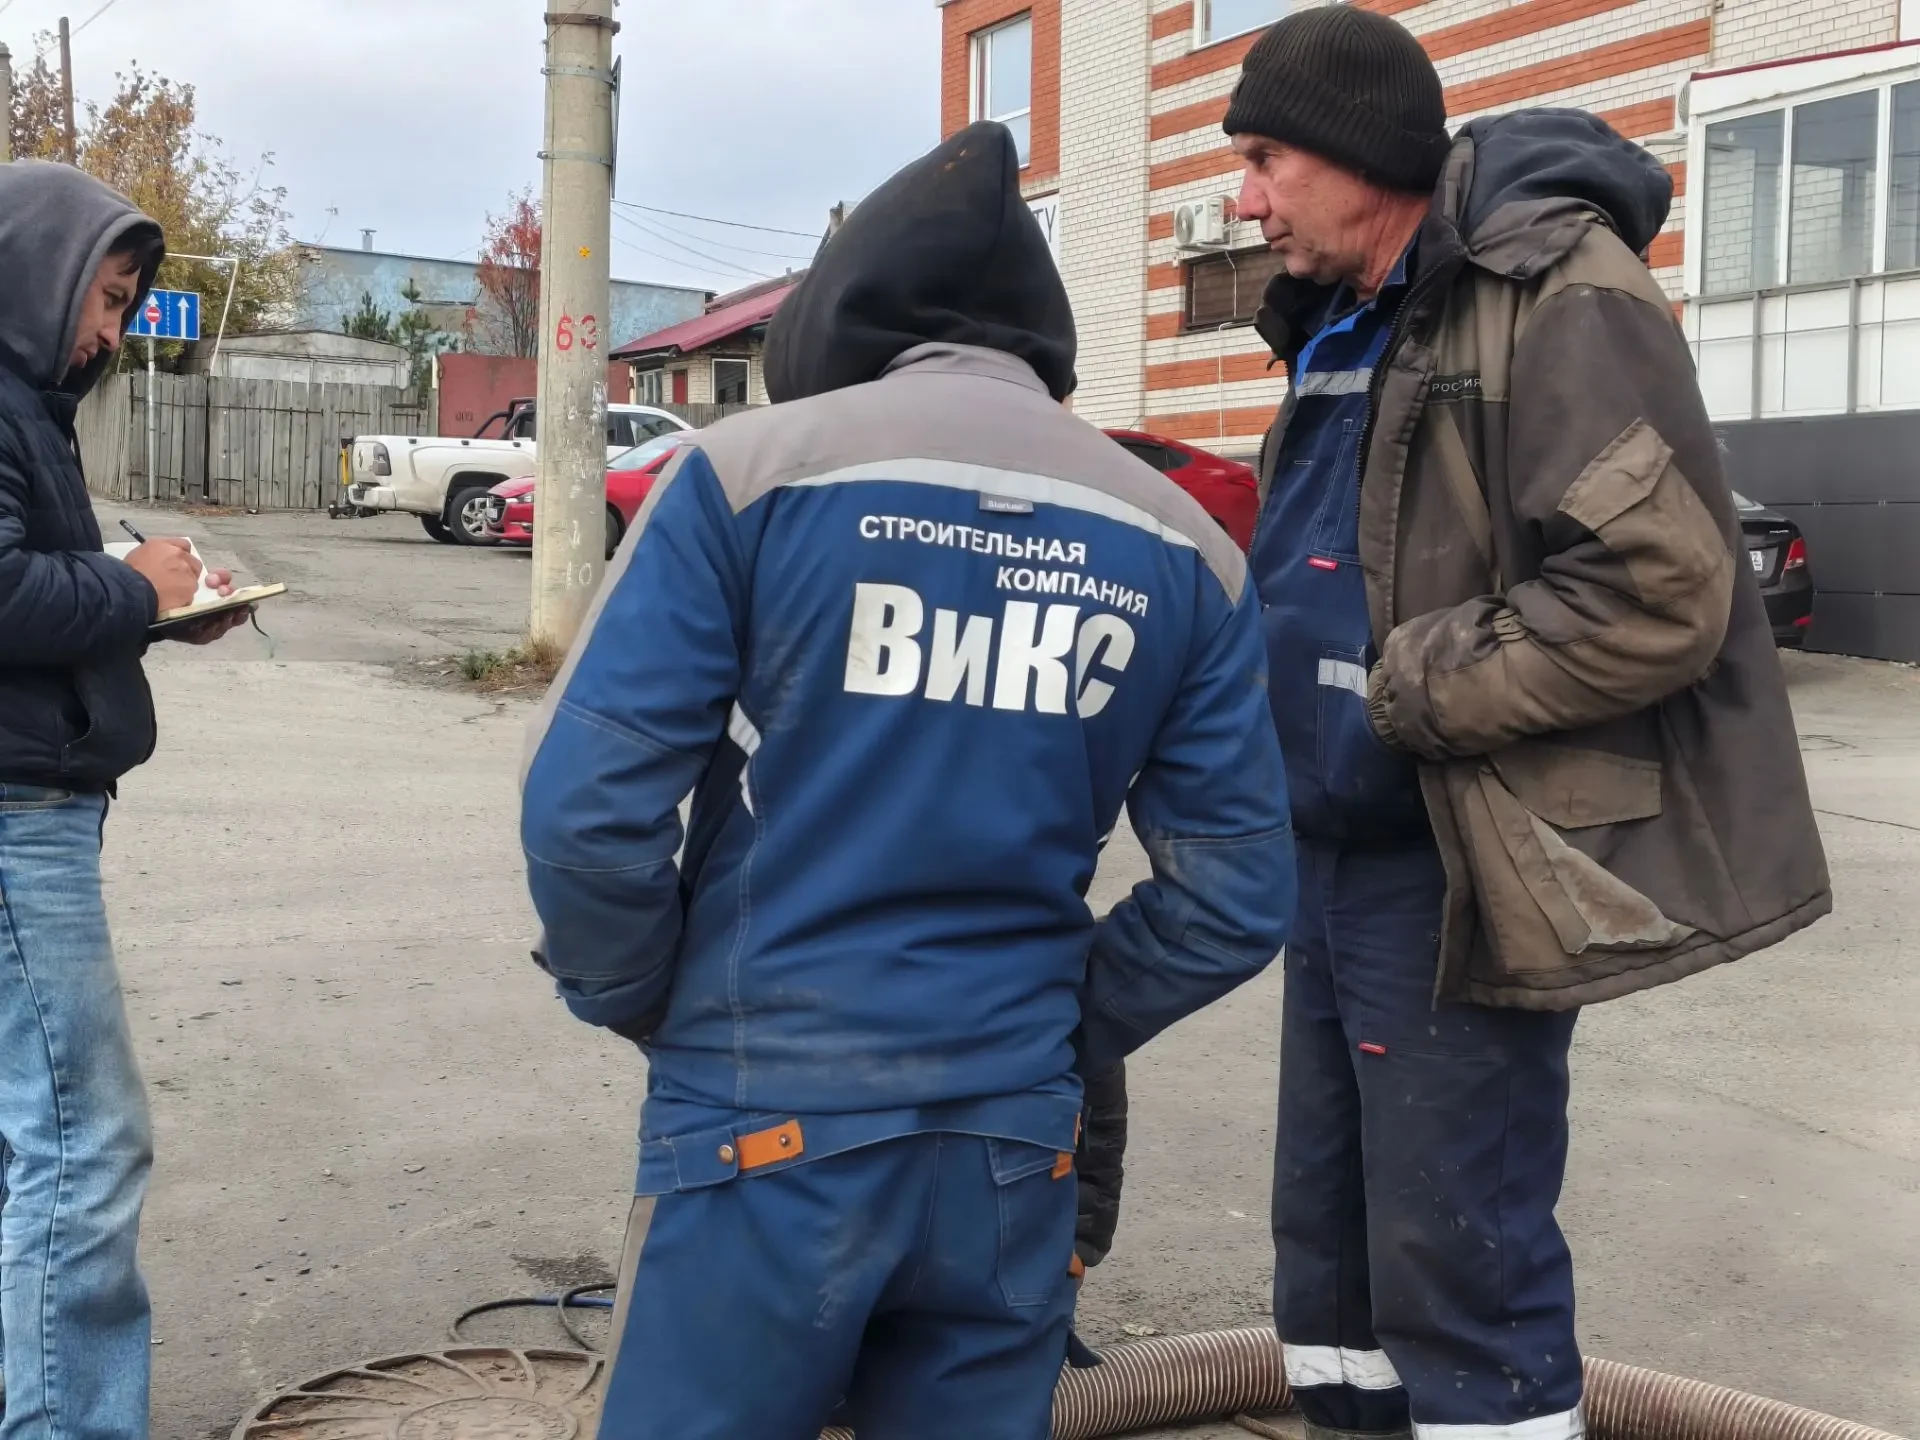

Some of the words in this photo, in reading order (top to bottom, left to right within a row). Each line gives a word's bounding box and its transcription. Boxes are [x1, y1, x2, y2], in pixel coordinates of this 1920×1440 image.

[556, 314, 597, 351] 63
[859, 515, 1086, 565] СТРОИТЕЛЬНАЯ
[996, 565, 1149, 617] КОМПАНИЯ
[843, 582, 1135, 719] ВиКС
